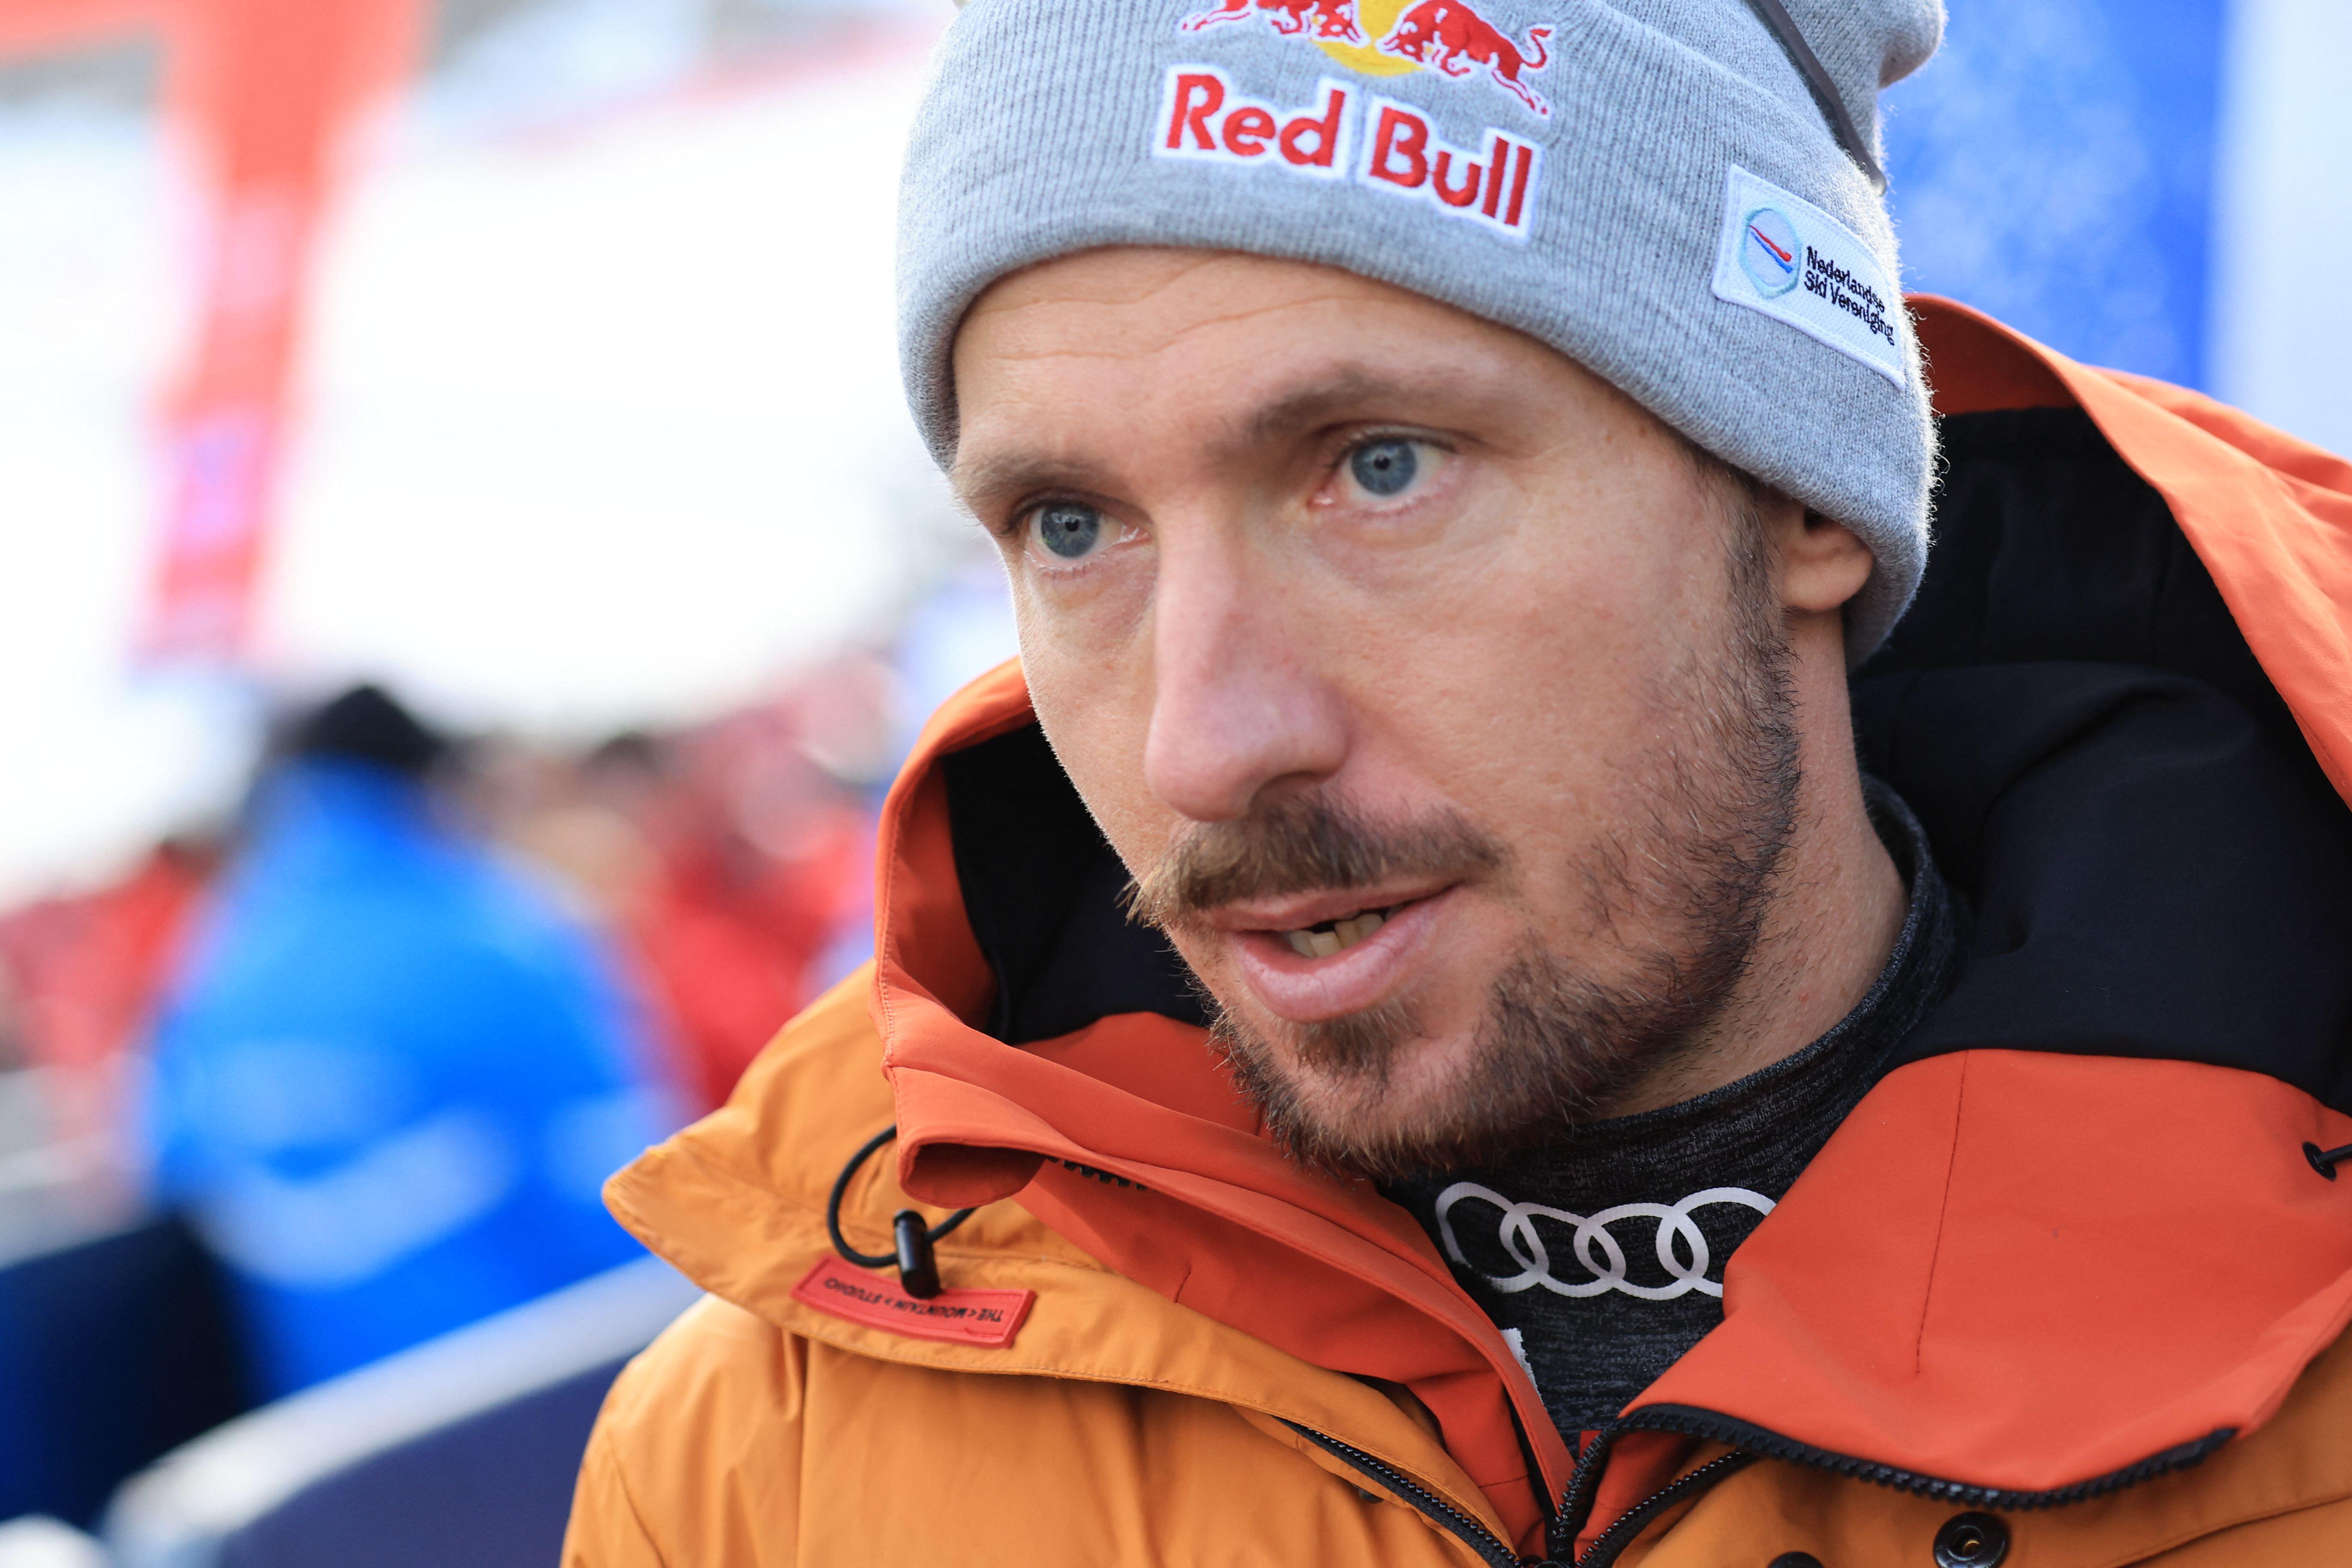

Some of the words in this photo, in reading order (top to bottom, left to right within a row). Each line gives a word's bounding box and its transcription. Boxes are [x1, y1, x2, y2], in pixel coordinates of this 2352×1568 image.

[1166, 74, 1346, 167] Red
[1369, 105, 1532, 227] Bull
[1806, 245, 1885, 313] Nederlandse
[1804, 270, 1828, 299] Ski
[1829, 281, 1895, 346] Vereniging
[824, 1278, 883, 1305] STUDIO
[893, 1300, 967, 1319] MOUNTAIN
[976, 1308, 1004, 1323] THE
